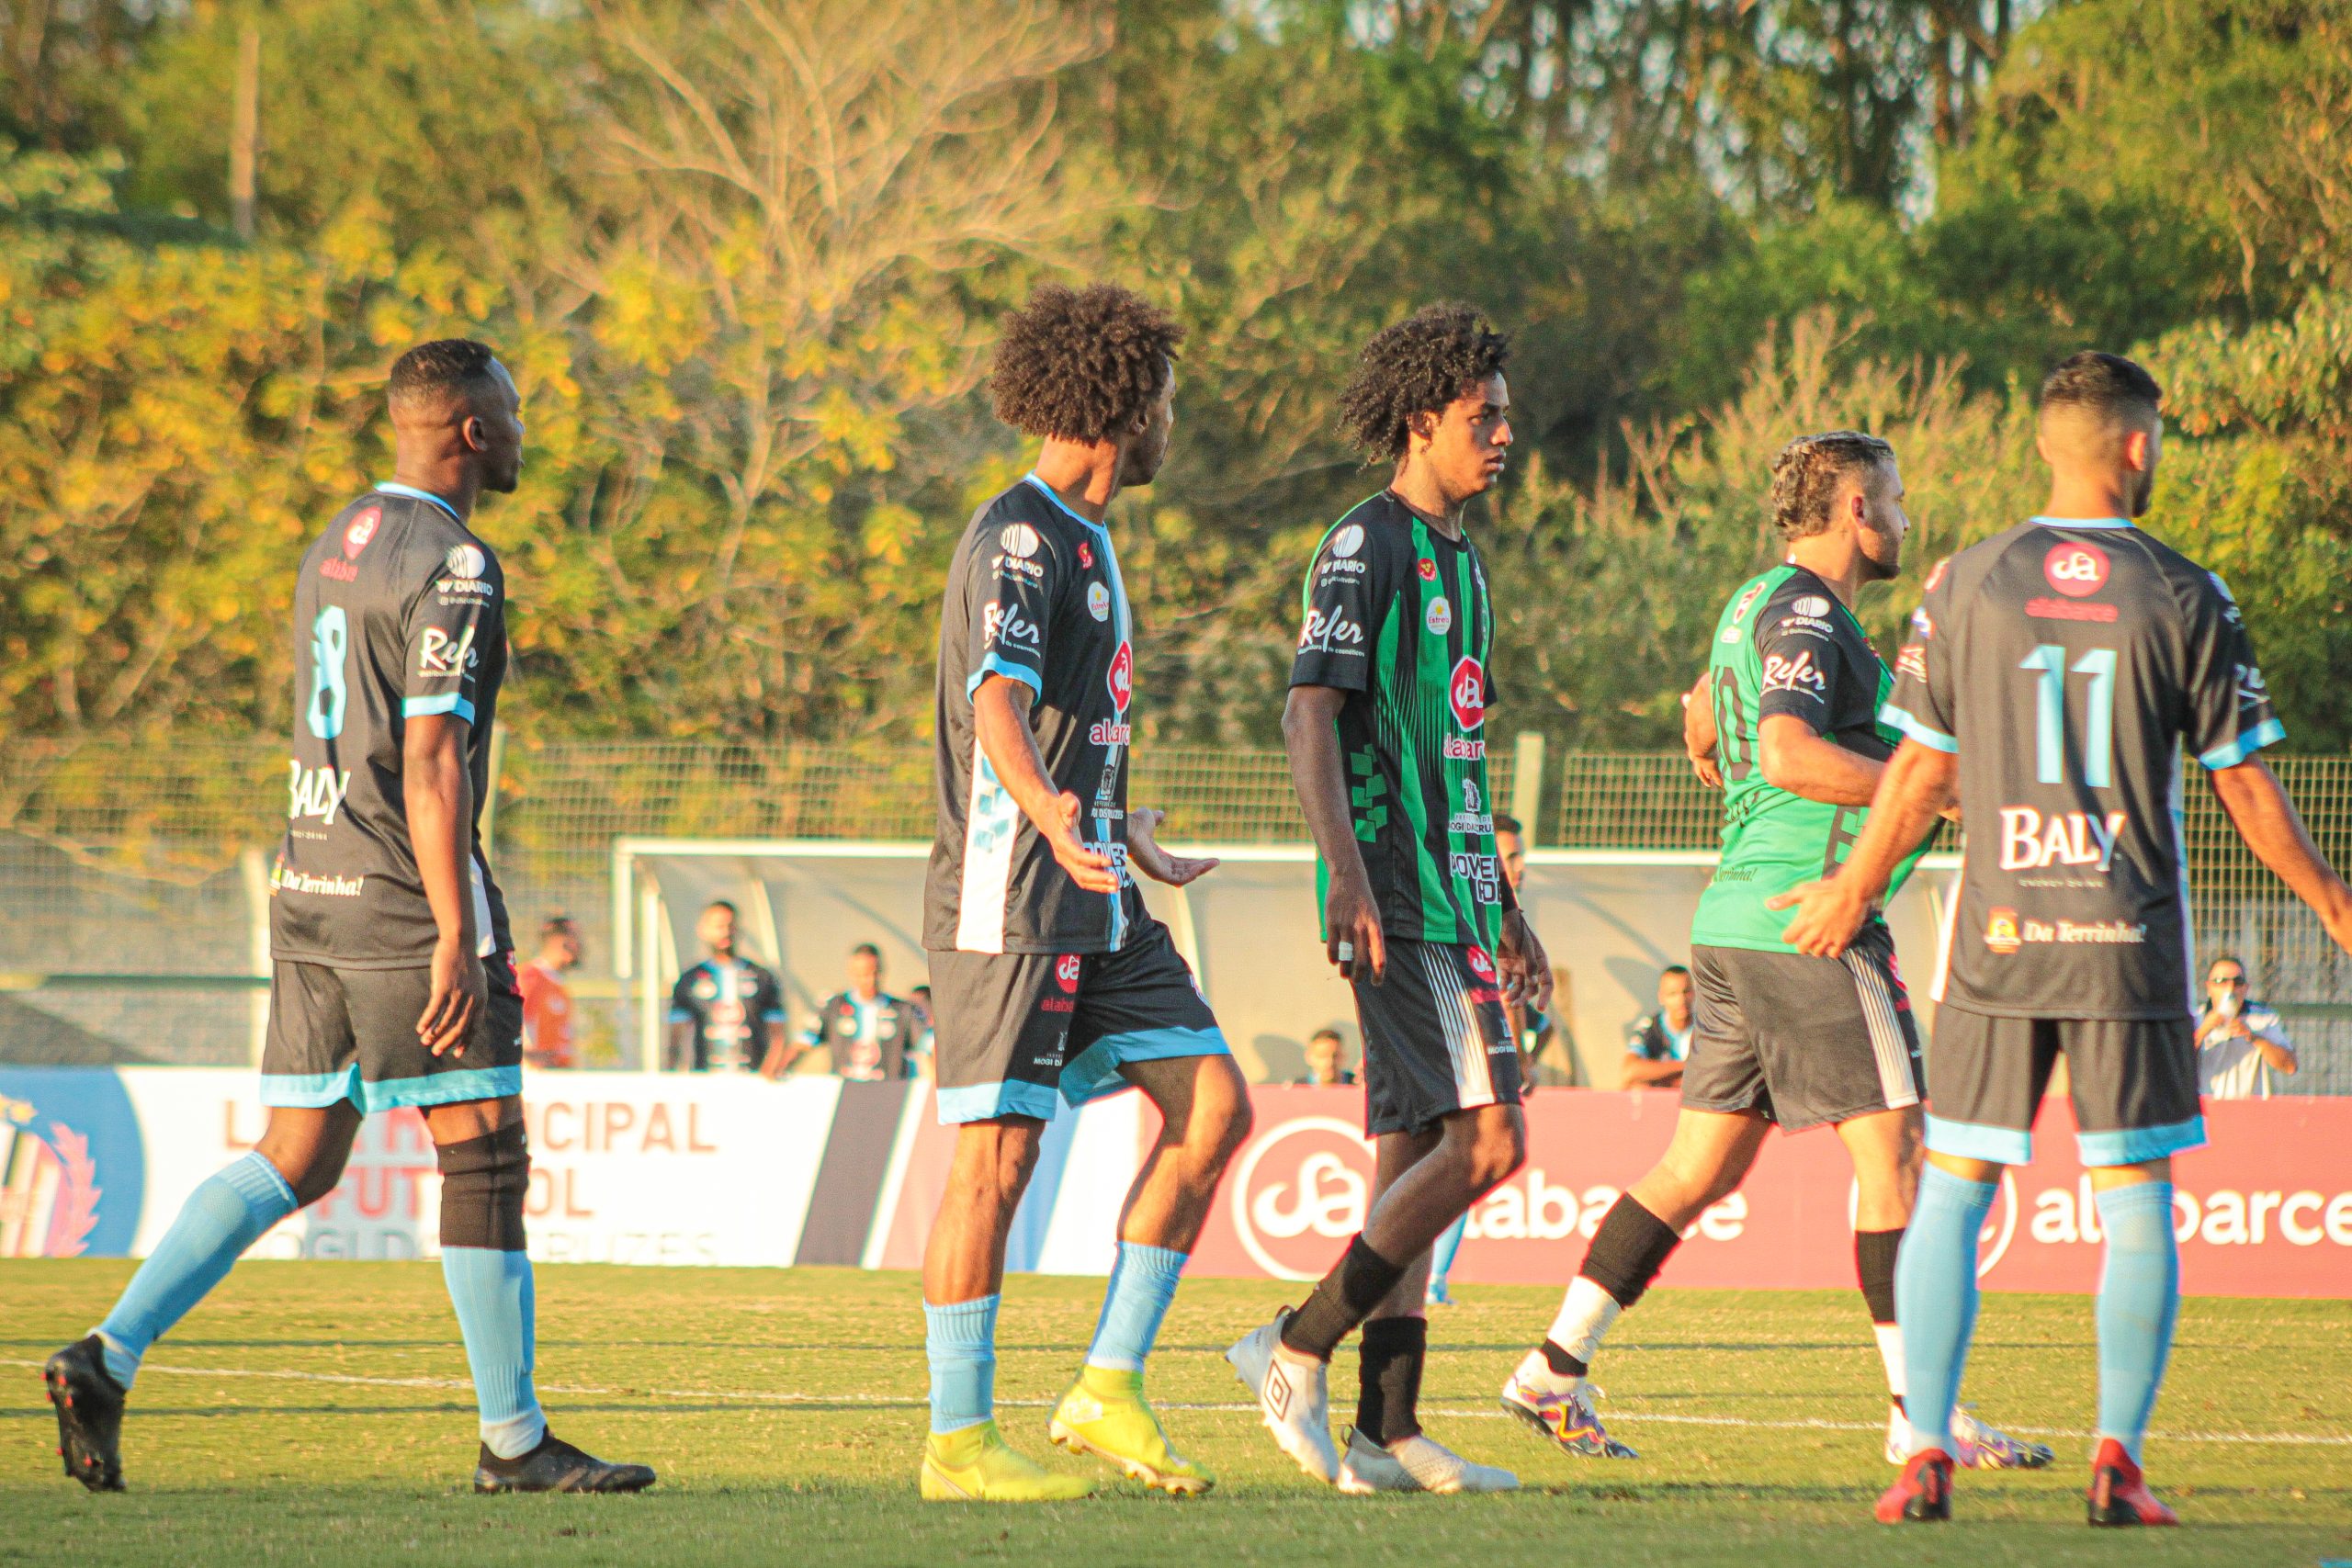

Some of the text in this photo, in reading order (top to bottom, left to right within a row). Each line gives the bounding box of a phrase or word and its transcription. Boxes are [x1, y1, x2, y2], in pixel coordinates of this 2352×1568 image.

[454, 580, 493, 596] DIARIO
[1004, 558, 1044, 578] DIARIO
[1300, 604, 1363, 652] Refer
[1794, 616, 1834, 634] DIARIO
[309, 604, 347, 739] 8
[1763, 652, 1826, 697] Refer
[1712, 665, 1753, 781] 0
[2019, 645, 2118, 788] 11
[1451, 822, 1464, 831] OGI
[2000, 806, 2128, 873] BALY
[300, 871, 365, 897] Terrinha!
[2023, 918, 2148, 944] Da Terrinha!
[317, 1164, 594, 1219] FUTOL
[2030, 1171, 2352, 1247] alarce
